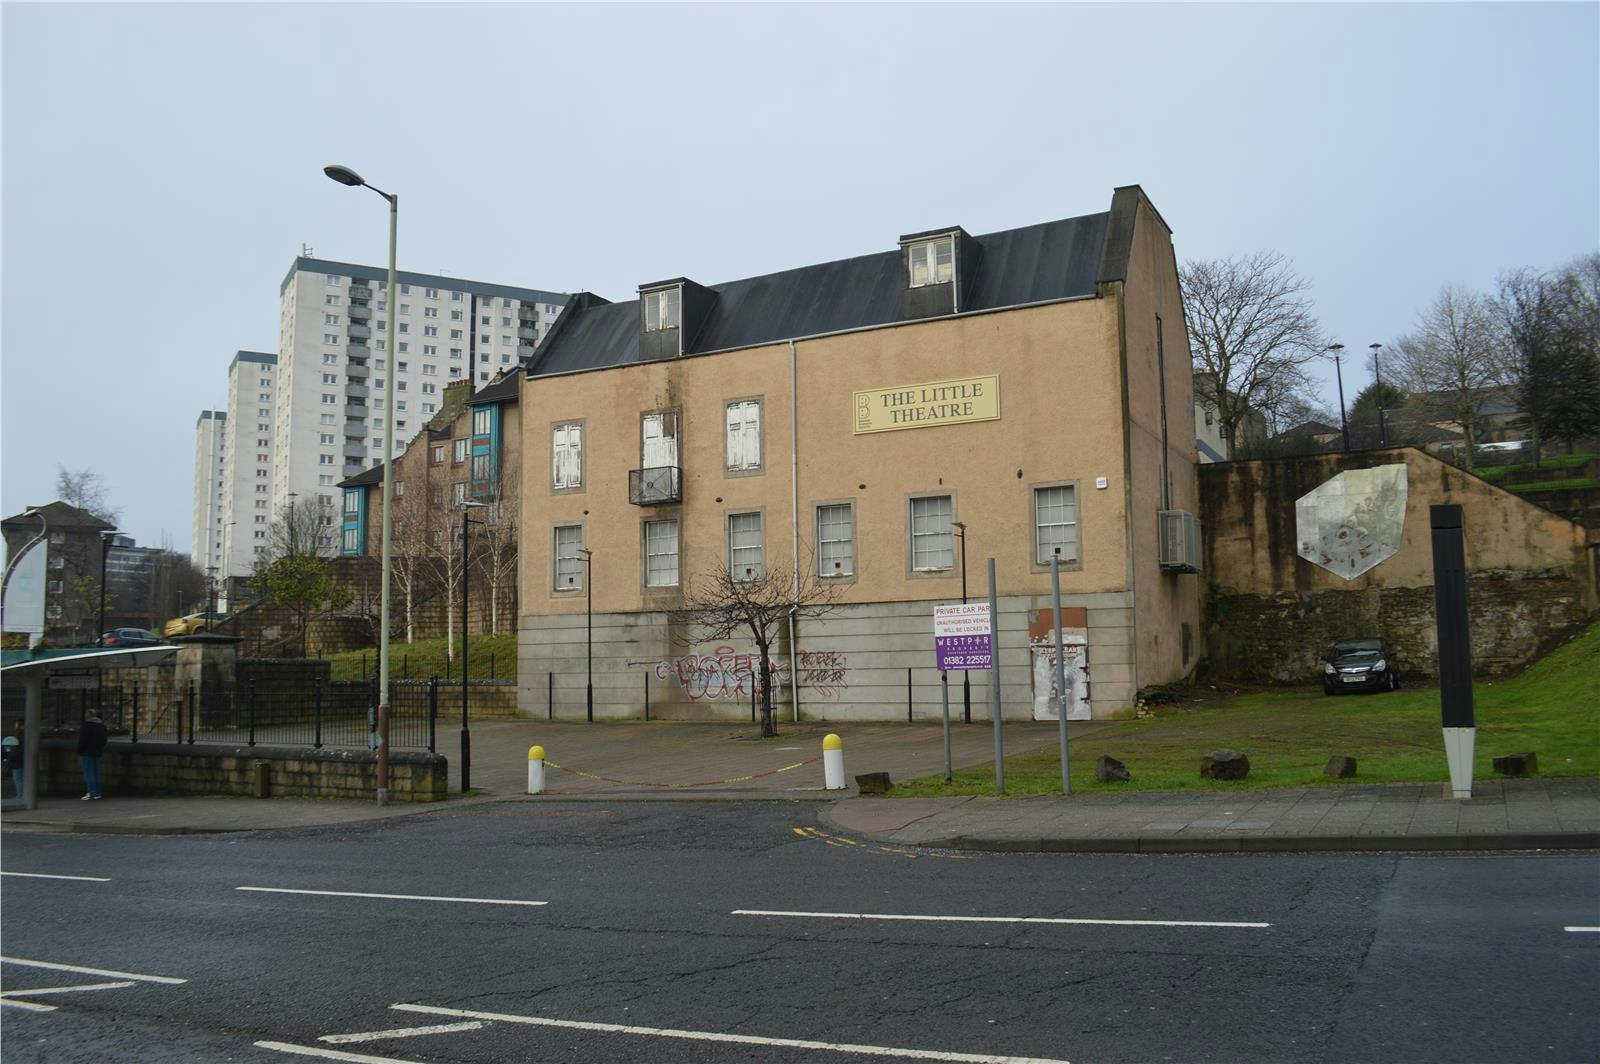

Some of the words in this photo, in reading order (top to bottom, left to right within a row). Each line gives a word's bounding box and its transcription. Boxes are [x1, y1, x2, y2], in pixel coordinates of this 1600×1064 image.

[880, 391, 916, 407] THE
[921, 383, 984, 403] LITTLE
[890, 401, 974, 423] THEATRE
[936, 607, 961, 615] PRIVATE
[944, 656, 964, 665] 01382
[966, 655, 991, 664] 225517
